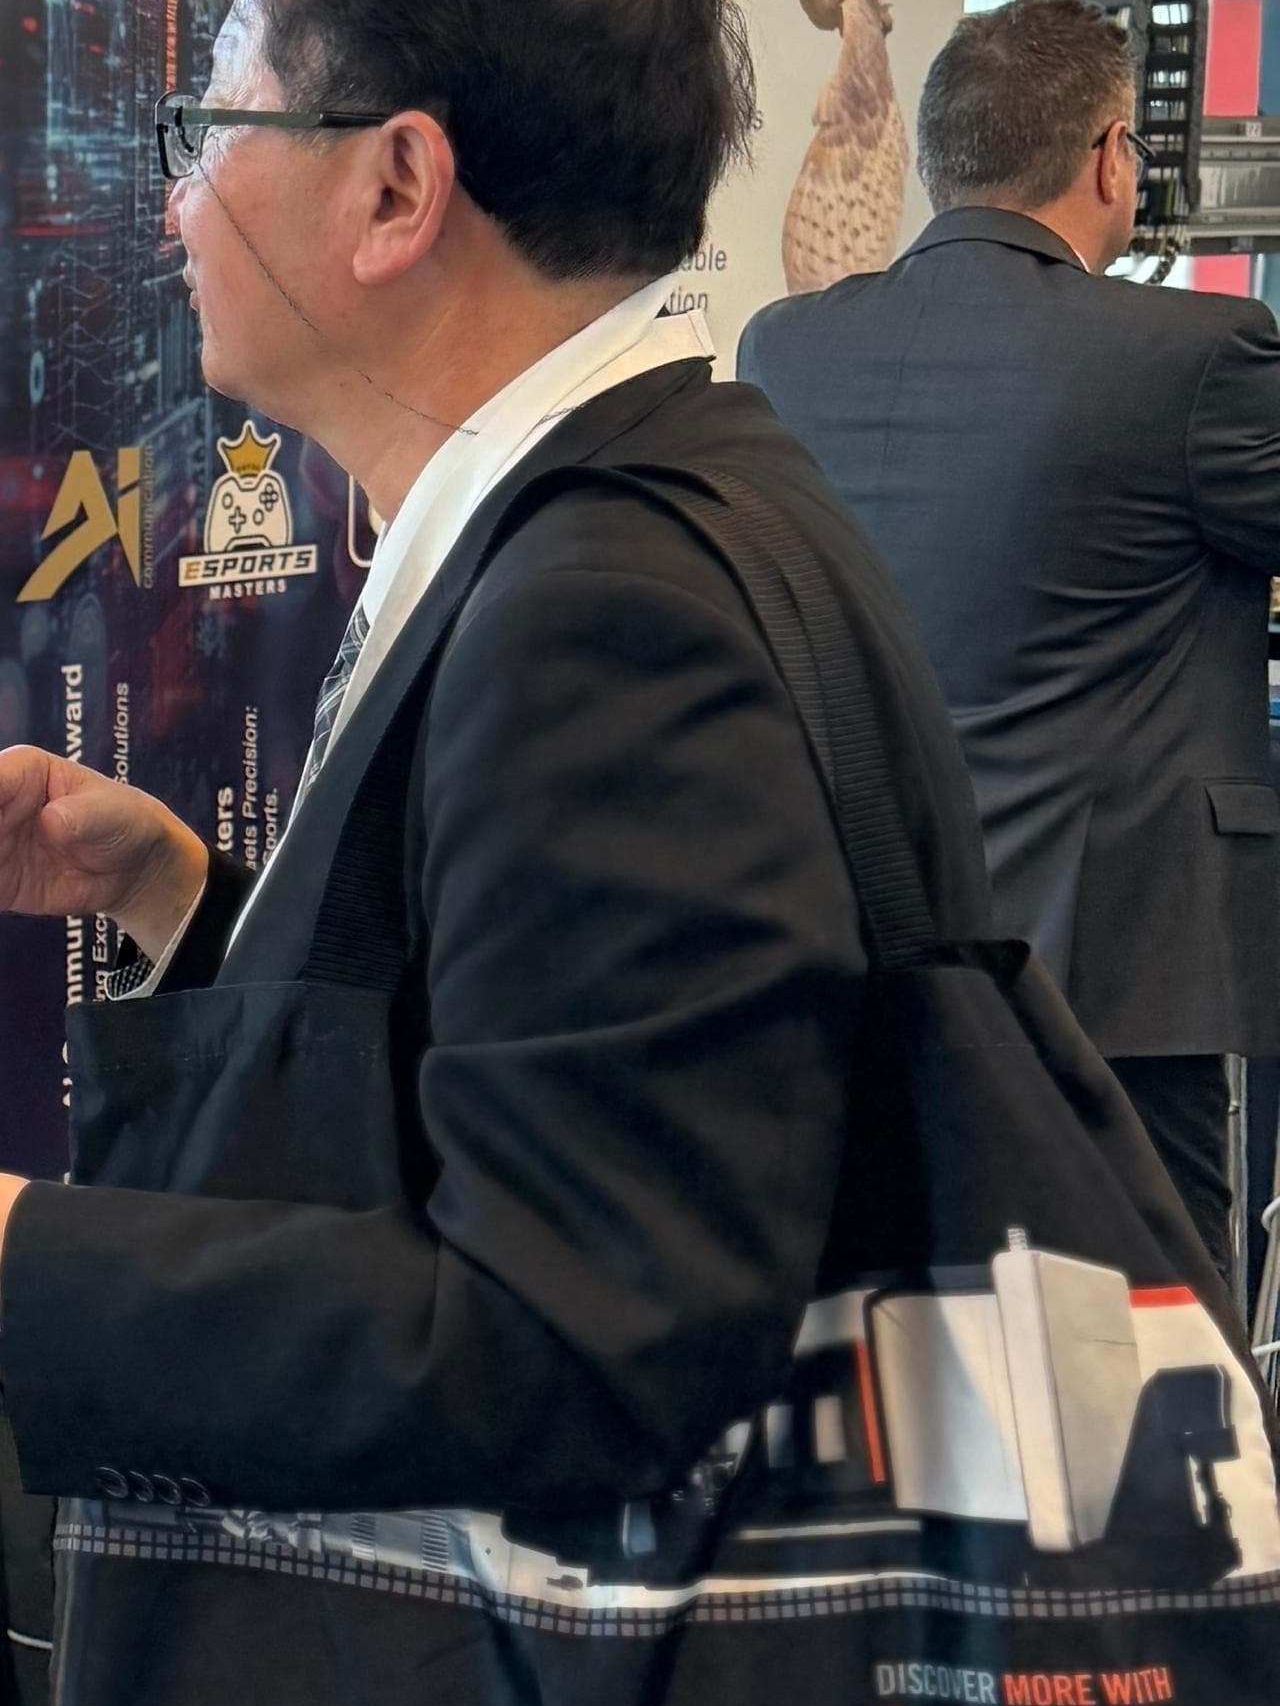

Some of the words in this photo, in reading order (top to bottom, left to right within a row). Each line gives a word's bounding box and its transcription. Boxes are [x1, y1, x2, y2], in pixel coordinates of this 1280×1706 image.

[183, 550, 314, 581] ESPORTS
[208, 579, 287, 601] MASTERS
[242, 705, 259, 820] Precision:
[875, 1661, 998, 1706] DISCOVER
[1100, 1665, 1174, 1705] WITH
